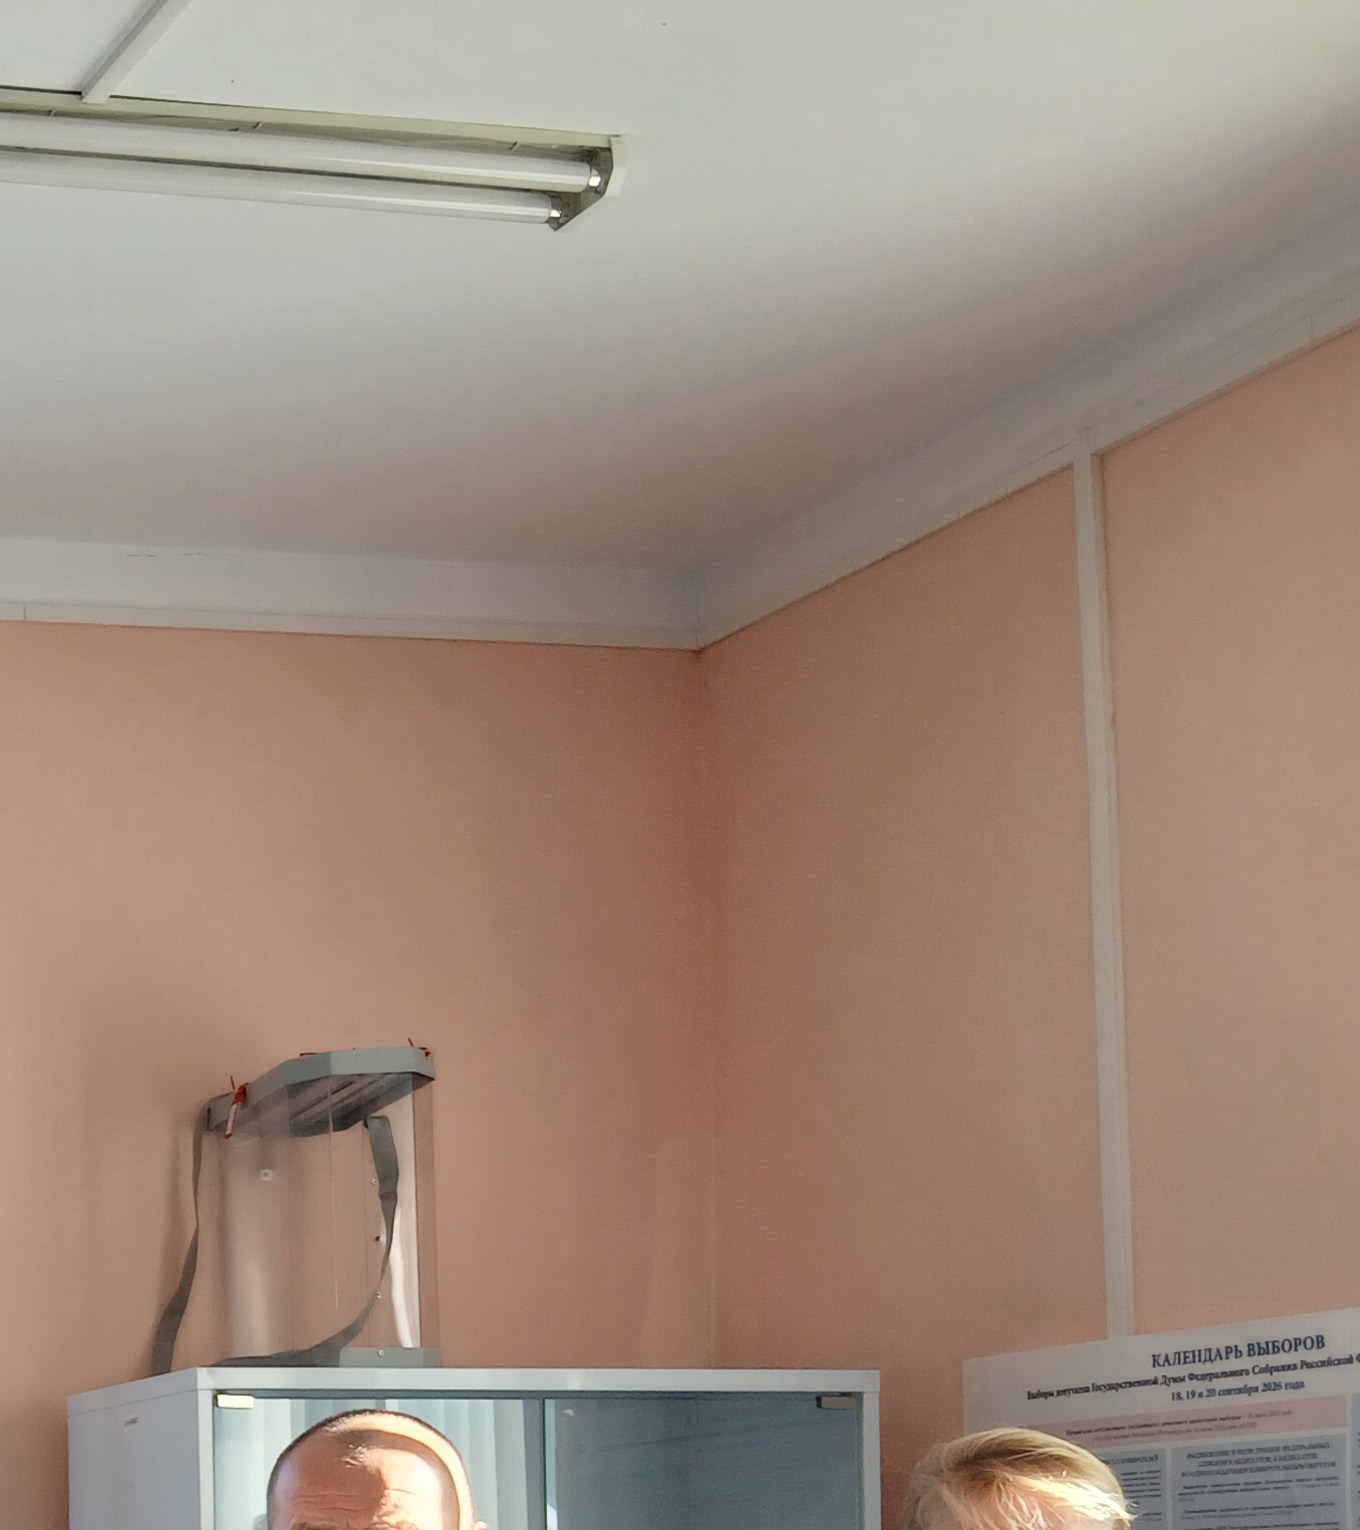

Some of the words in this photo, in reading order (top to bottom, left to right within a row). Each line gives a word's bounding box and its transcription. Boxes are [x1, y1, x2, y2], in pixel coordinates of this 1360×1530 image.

[1151, 1344, 1244, 1369] КАЛЕНДАРЬ
[1246, 1333, 1326, 1358] ВЫБОРОВ
[1186, 1390, 1196, 1399] 19
